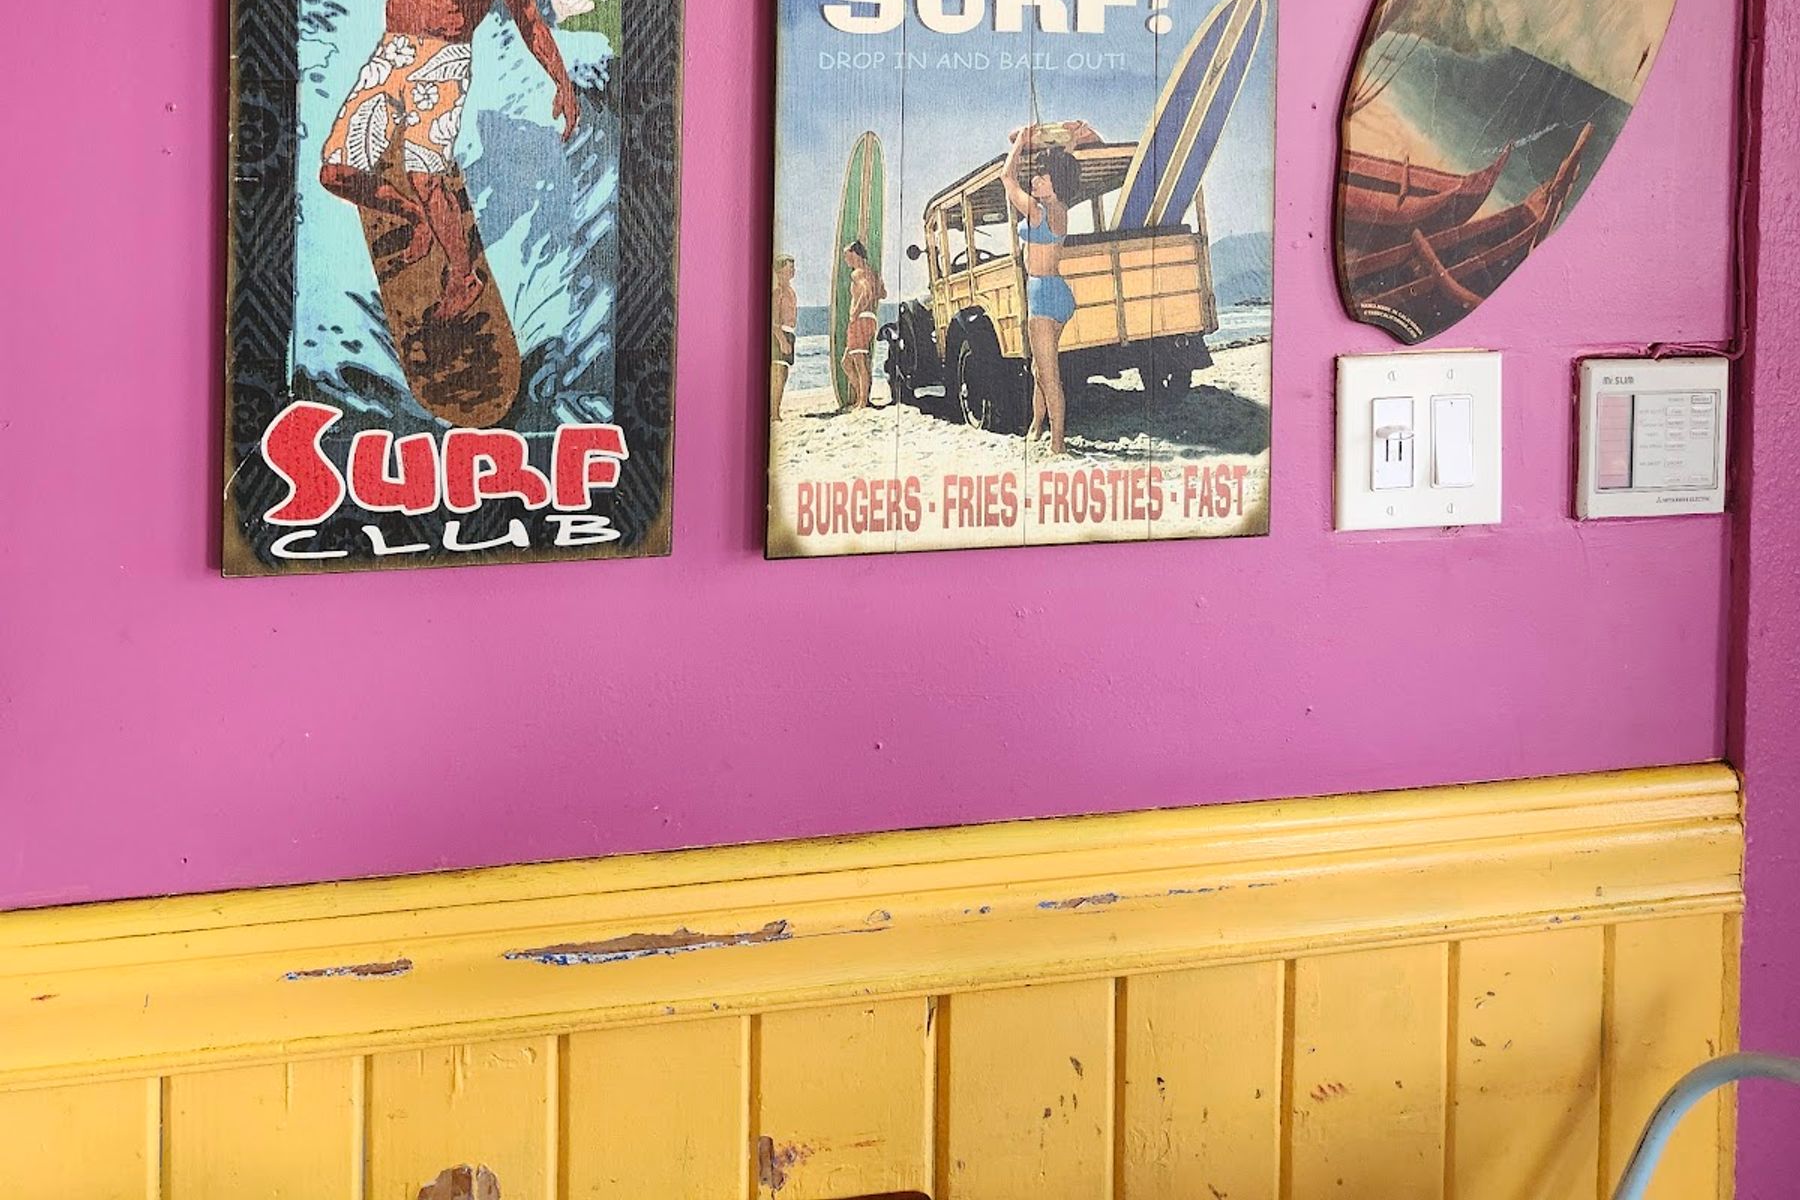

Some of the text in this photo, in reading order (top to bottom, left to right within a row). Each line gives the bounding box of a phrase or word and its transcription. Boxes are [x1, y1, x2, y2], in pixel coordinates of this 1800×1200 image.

[818, 52, 1126, 71] DROP IN AND BAIL OUT!
[260, 400, 630, 526] SURF
[796, 463, 1249, 538] BURGERS FRIES FROSTIES FAST
[269, 514, 622, 559] CLUB
